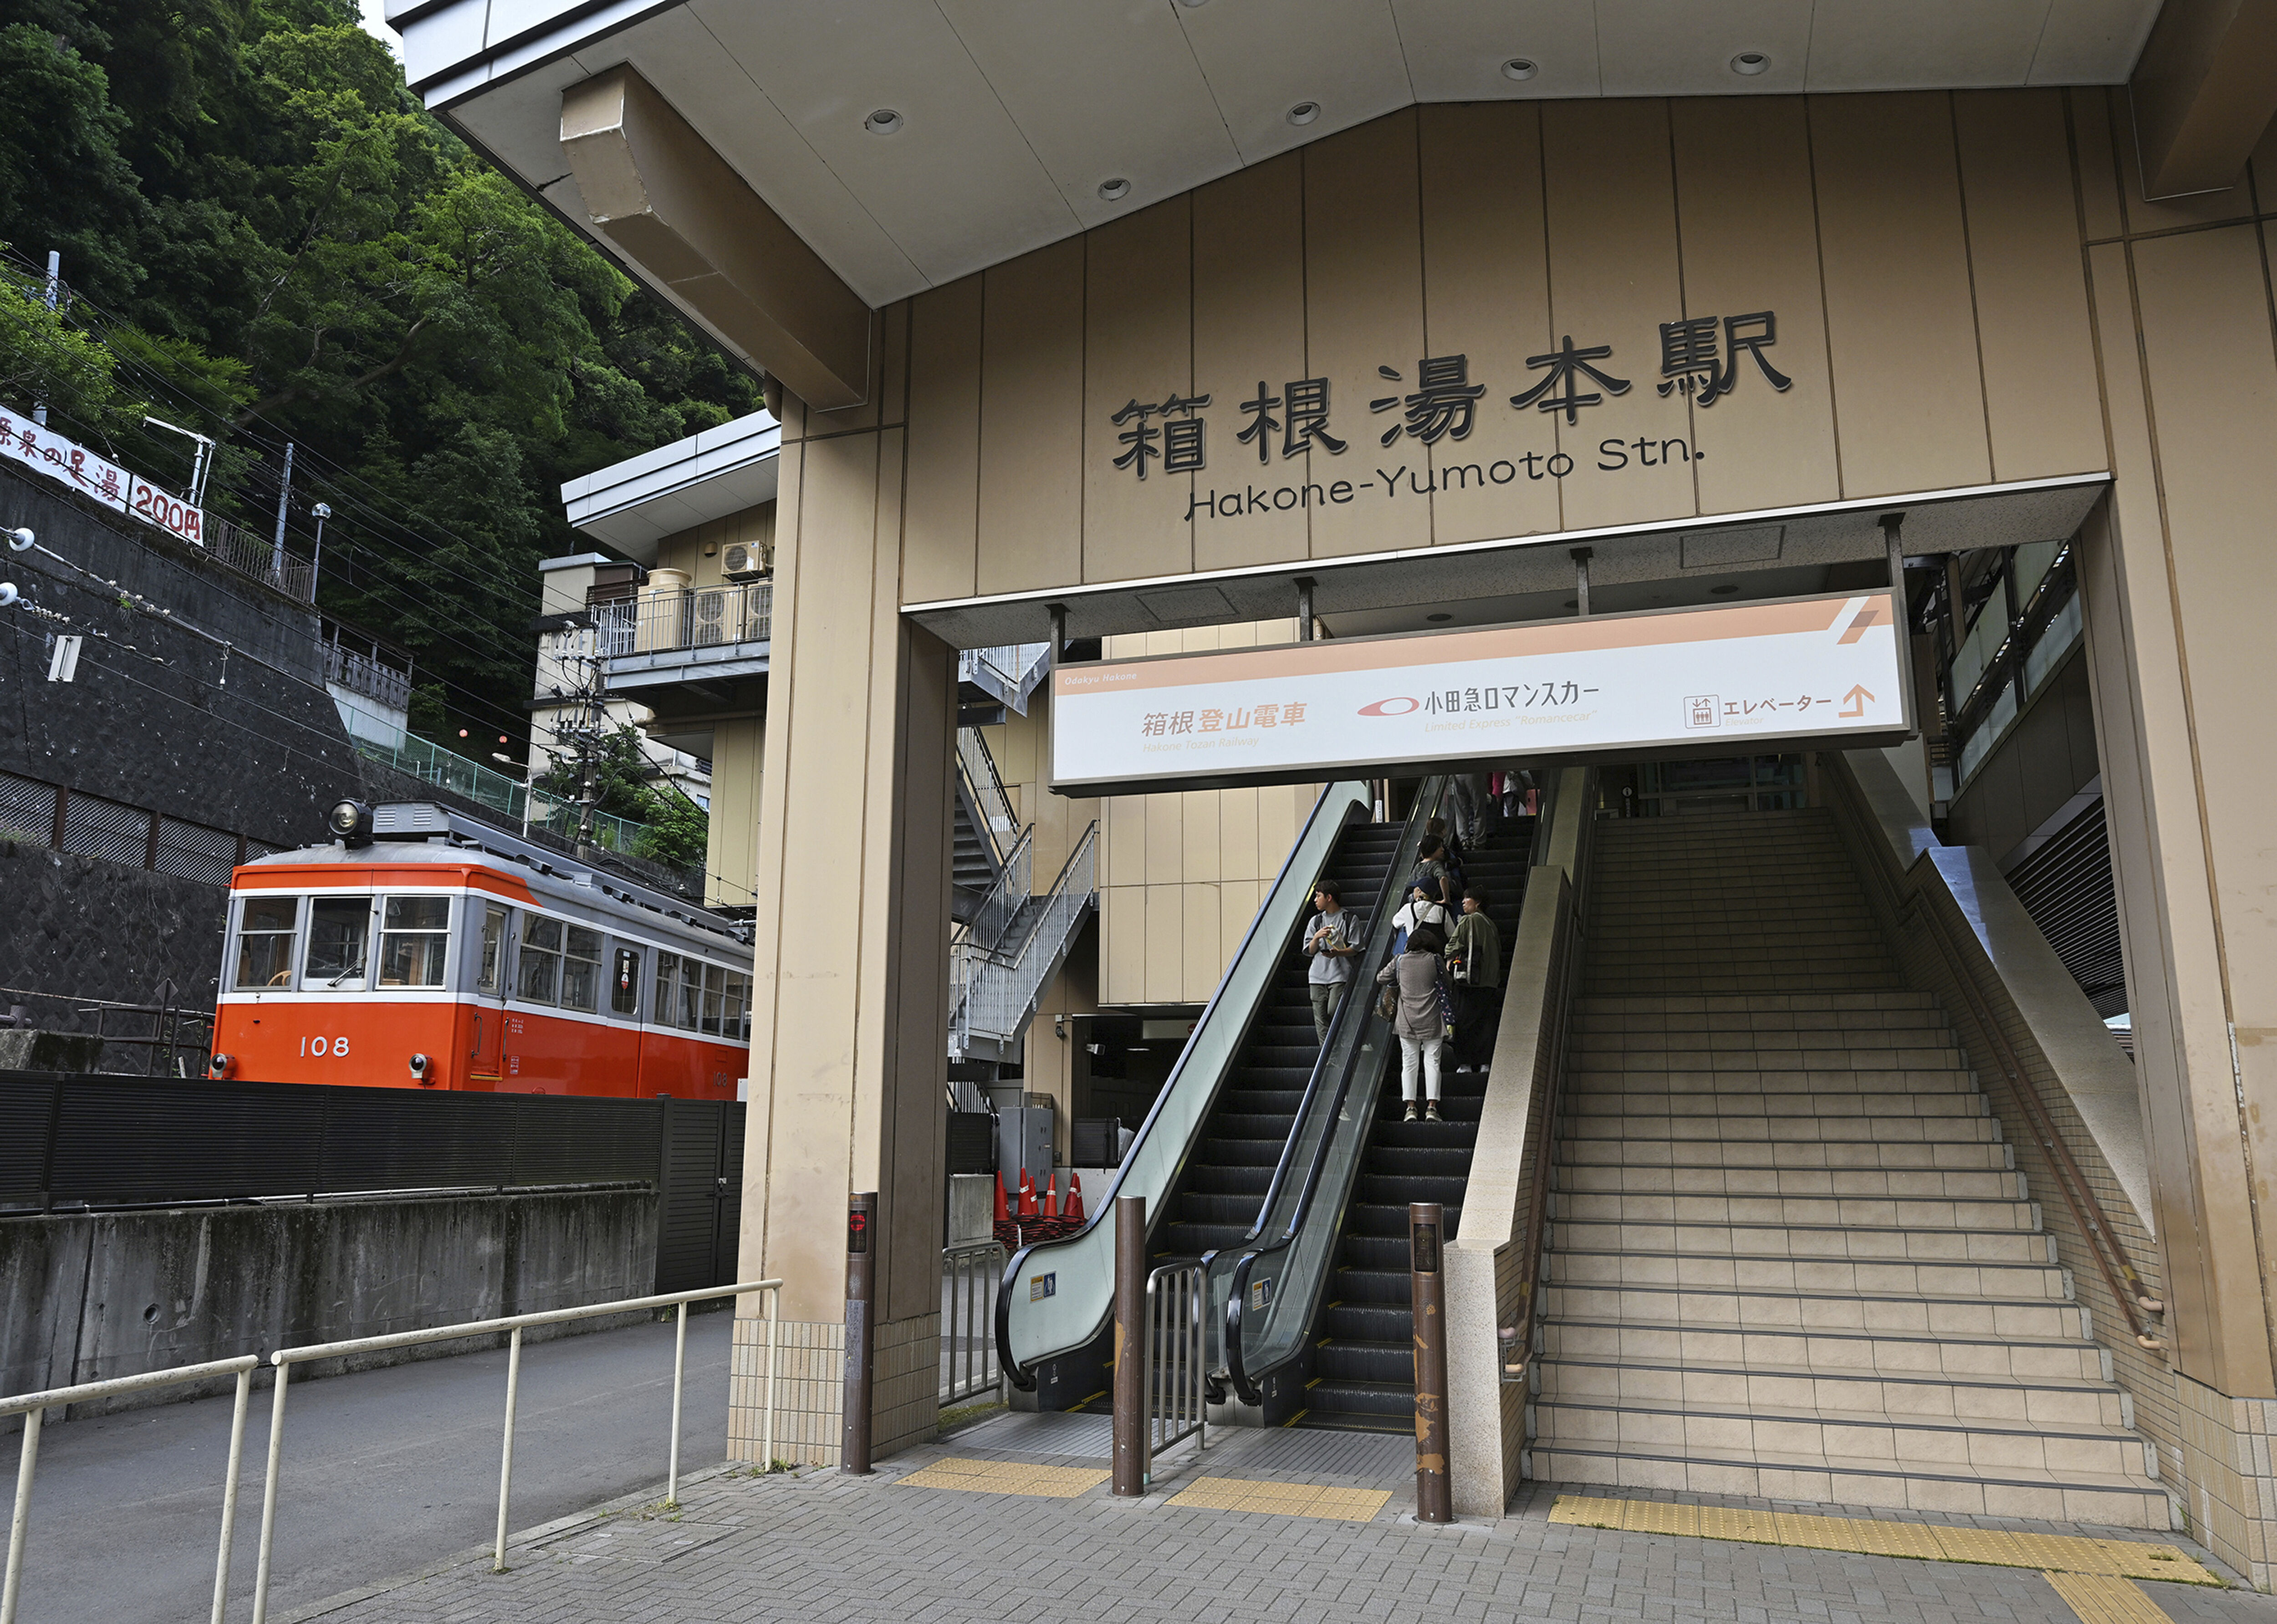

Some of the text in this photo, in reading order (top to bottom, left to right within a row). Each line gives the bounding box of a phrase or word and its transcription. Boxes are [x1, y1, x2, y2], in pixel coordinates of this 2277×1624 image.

[1111, 310, 1792, 480] 箱根湯本駅
[1184, 435, 1706, 522] Hakone-Yumoto Stn.
[137, 485, 200, 540] 200円
[1064, 672, 1137, 685] Odakyu Hakone
[1424, 680, 1599, 715] 小田急ロマンスカー
[1723, 694, 1832, 715] エレベーター
[1141, 701, 1307, 737] 箱根登山電車
[1424, 719, 1466, 733] Limited
[1469, 717, 1511, 731] Express
[1725, 717, 1764, 727] Elevator
[1142, 736, 1260, 753] Hakone Tozan Railway
[300, 1036, 350, 1057] 108
[713, 1071, 728, 1087] 108
